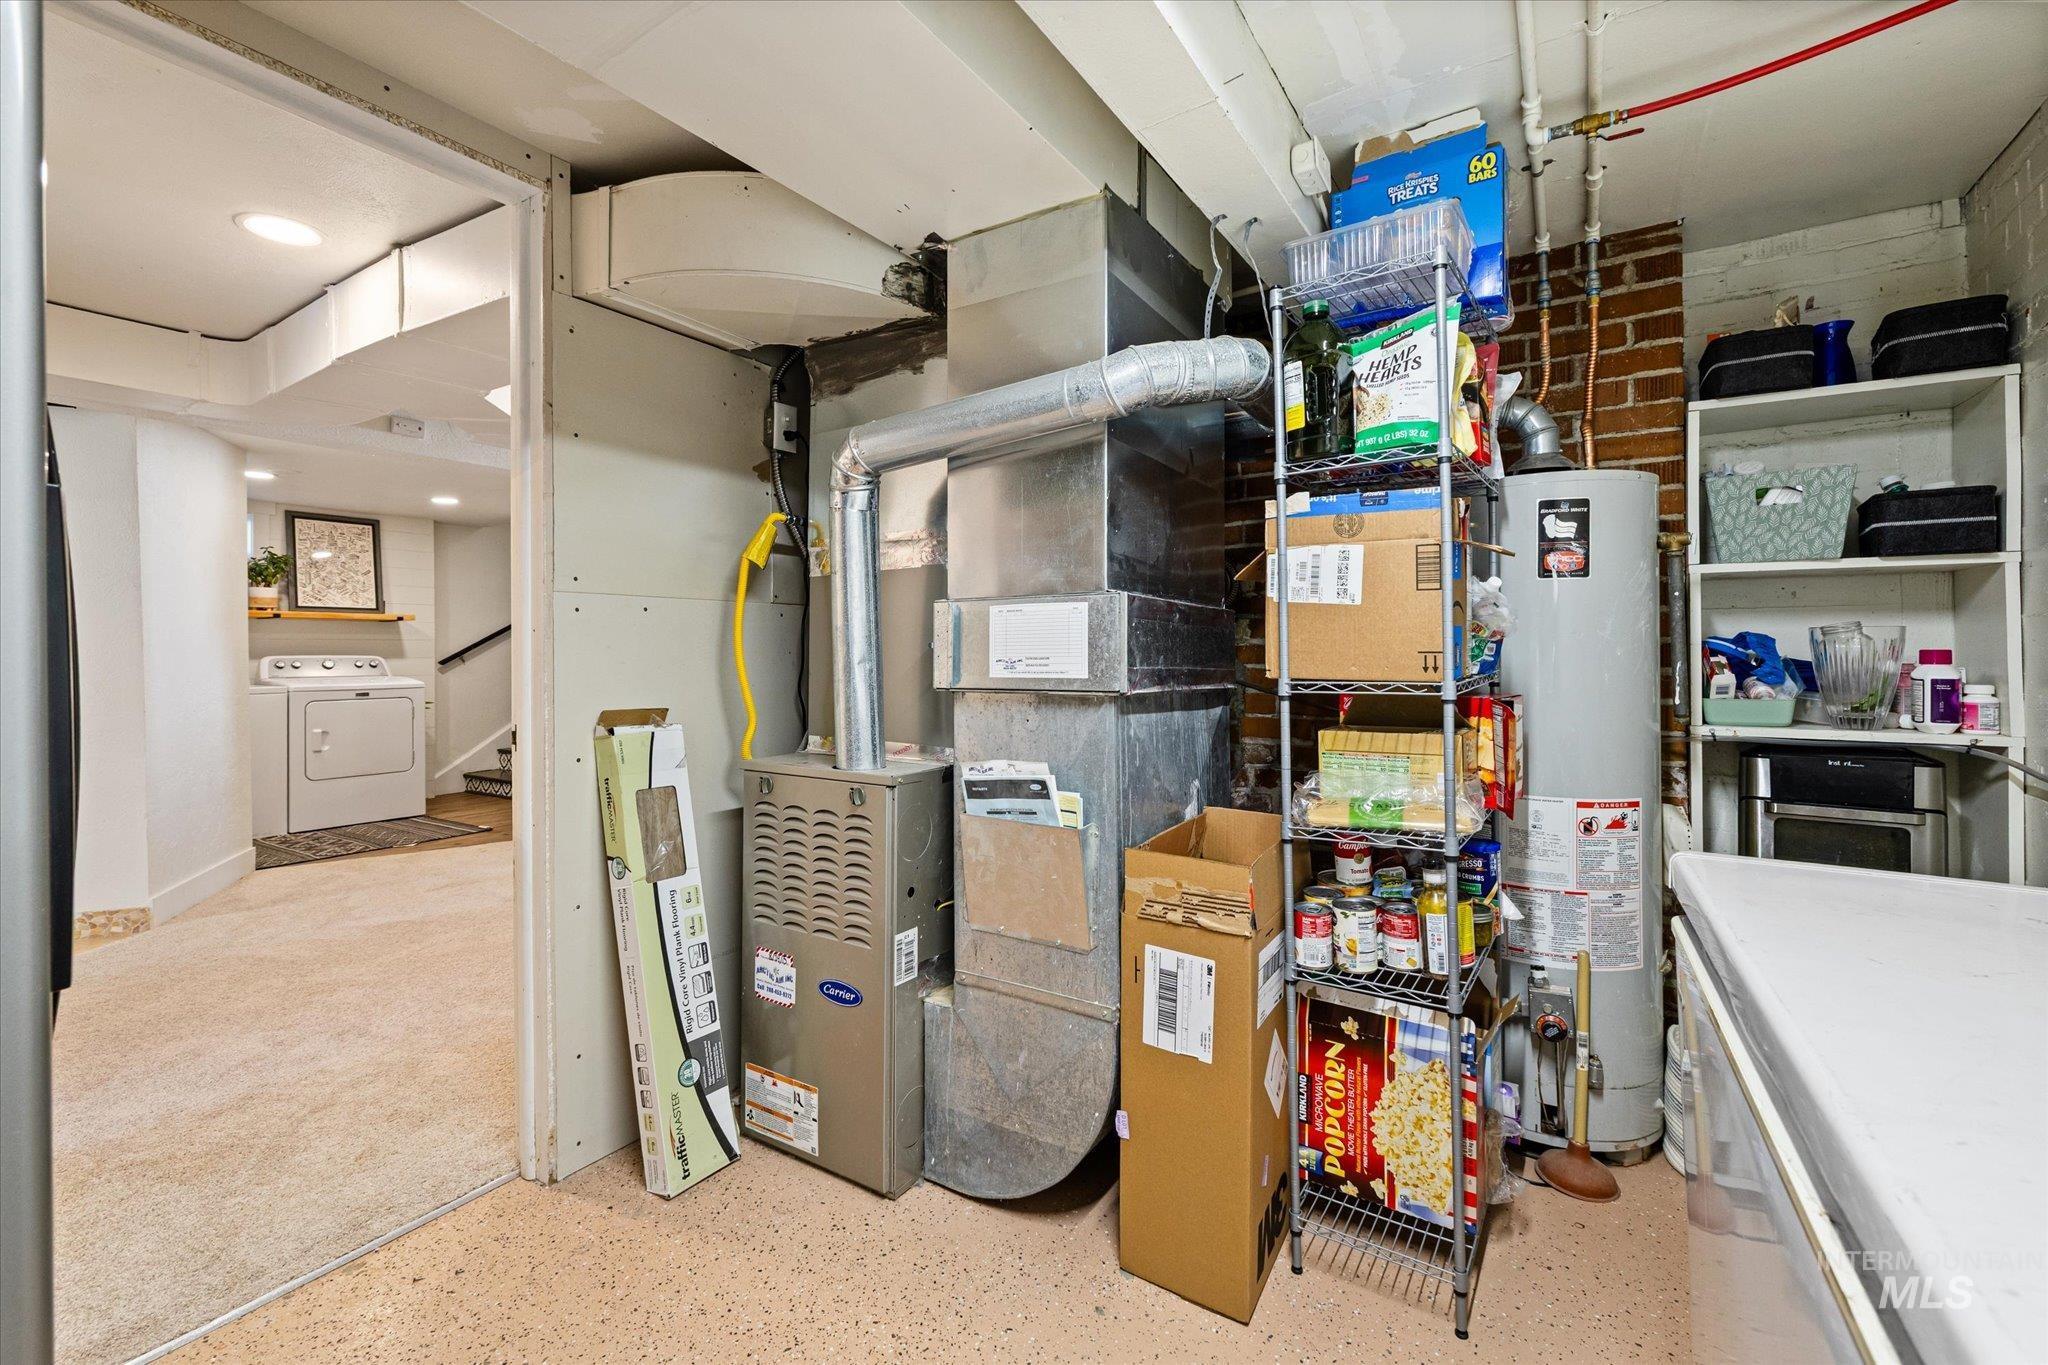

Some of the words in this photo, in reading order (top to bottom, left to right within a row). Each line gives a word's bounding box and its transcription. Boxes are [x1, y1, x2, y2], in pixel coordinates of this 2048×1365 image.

[1469, 152, 1497, 173] 60
[1388, 183, 1405, 195] RICE
[1405, 174, 1440, 189] KRISPIES
[1468, 168, 1498, 184] BARS
[1389, 182, 1438, 205] TREATS
[1360, 356, 1422, 383] HEARTS
[1369, 344, 1417, 372] HEMP
[1365, 437, 1377, 446] 907
[1391, 430, 1408, 442] LBS)
[1414, 487, 1441, 496] rime
[1461, 872, 1484, 882] CRUMBS
[669, 890, 680, 929] Flooring
[673, 930, 683, 956] Plank
[678, 957, 687, 983] Vinyl
[756, 966, 775, 982] ARCTIC
[1206, 964, 1215, 977] 3M
[682, 984, 690, 1007] Core
[823, 984, 856, 1001] Carrier
[684, 1009, 694, 1034] Rigid
[1299, 1074, 1307, 1121] KIRKLAND
[1315, 1073, 1324, 1132] MICROWAVE
[1324, 1039, 1346, 1178] POPCORN
[670, 1091, 690, 1180] trafficMASTER
